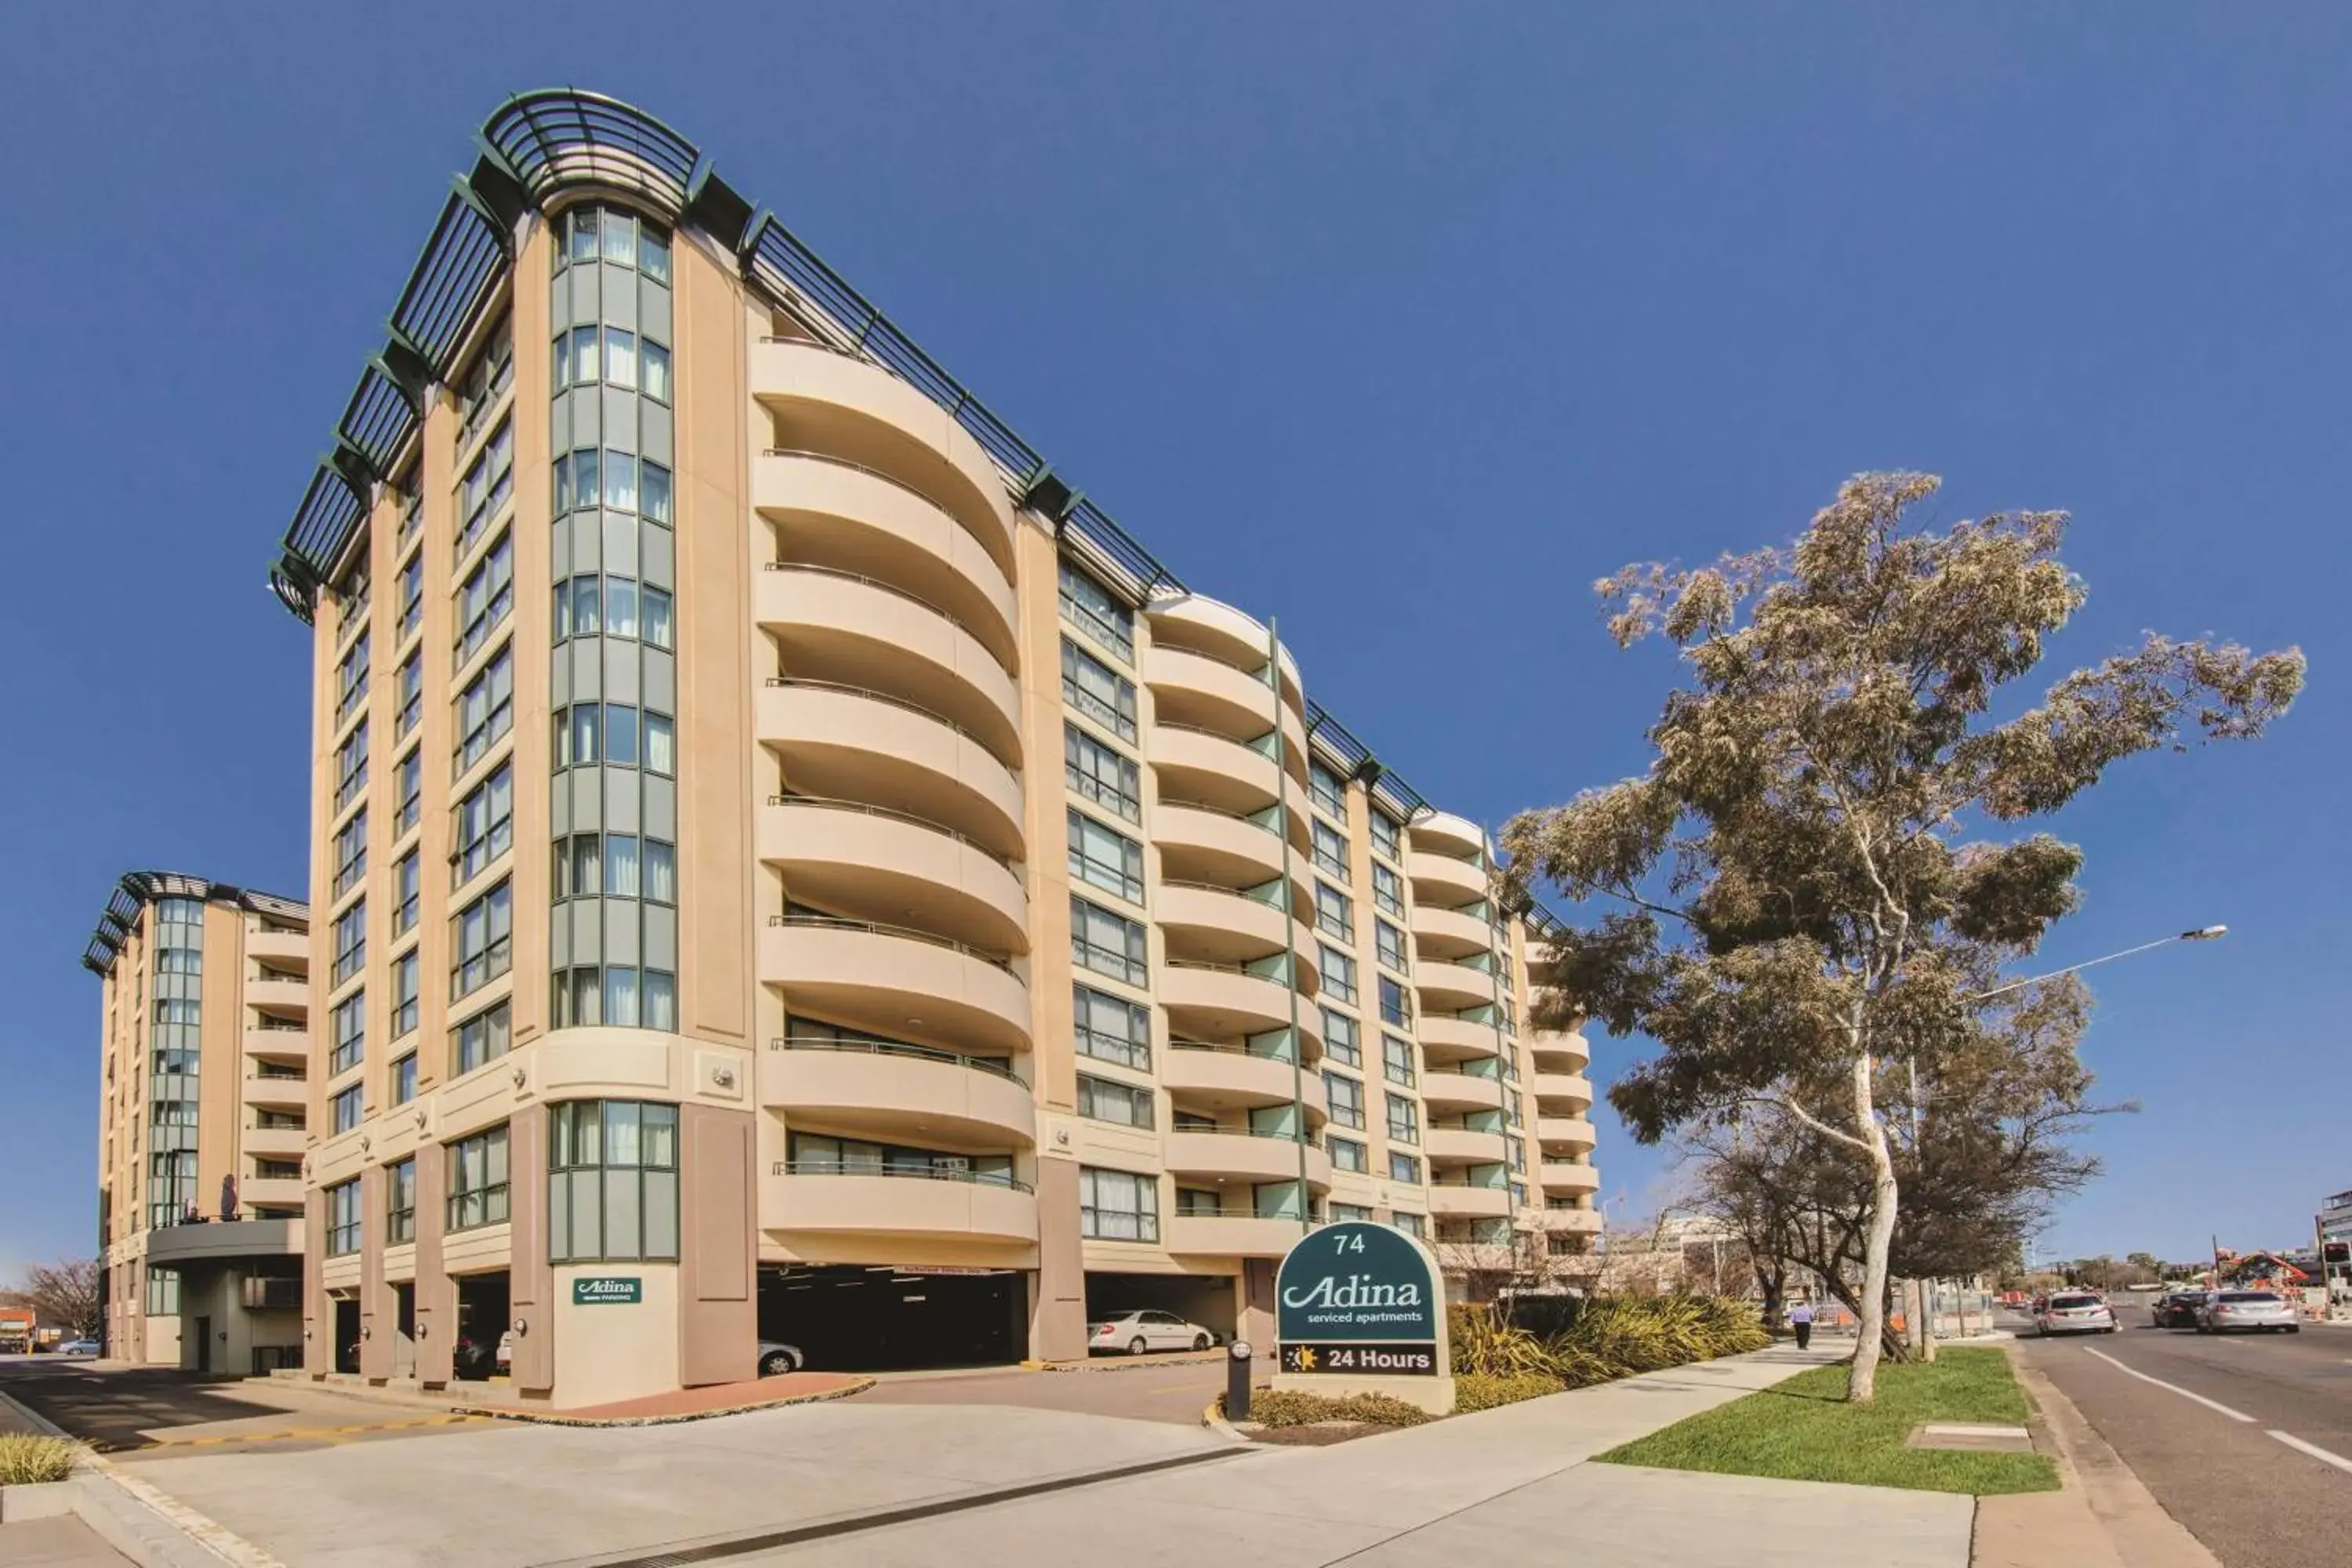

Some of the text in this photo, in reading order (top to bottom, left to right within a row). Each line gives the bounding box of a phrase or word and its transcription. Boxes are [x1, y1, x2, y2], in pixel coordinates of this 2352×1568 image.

[1334, 1233, 1365, 1254] 74
[578, 1280, 634, 1293] Adina
[1283, 1274, 1421, 1308] Adina
[1308, 1312, 1423, 1324] serviced apartments
[1329, 1349, 1431, 1369] 24 Hours
